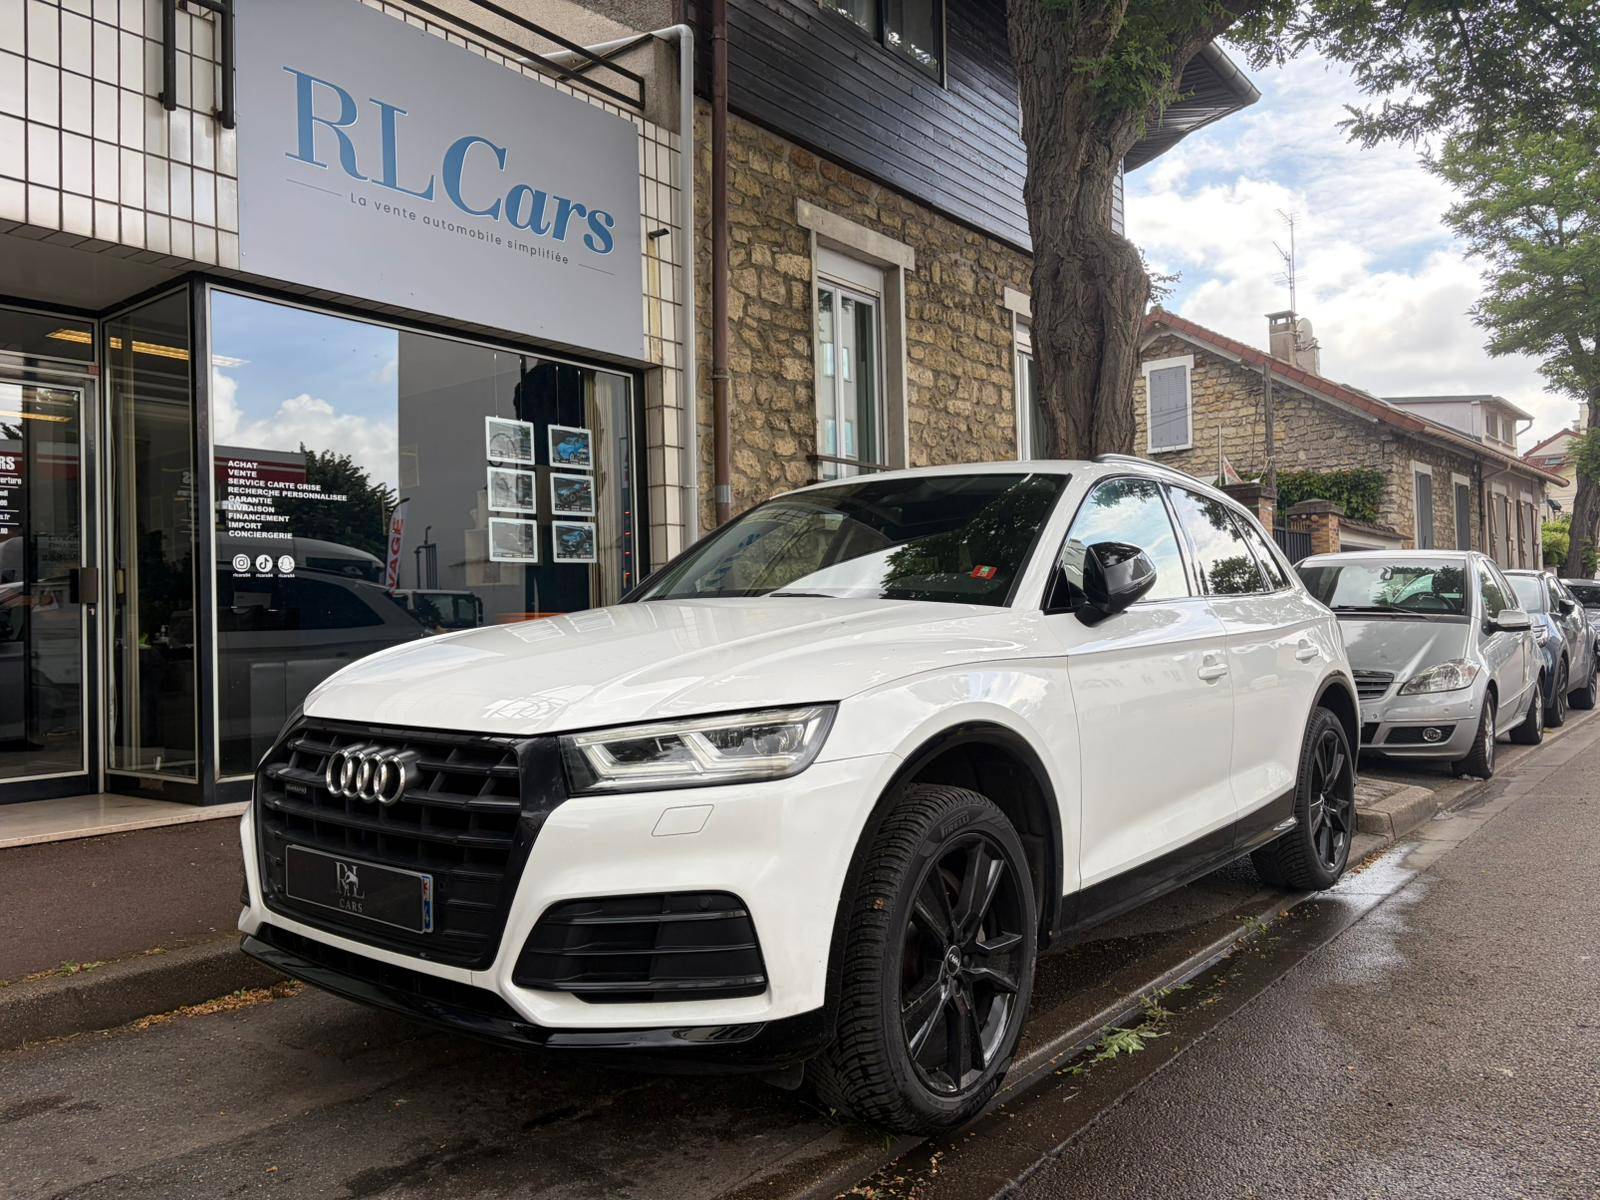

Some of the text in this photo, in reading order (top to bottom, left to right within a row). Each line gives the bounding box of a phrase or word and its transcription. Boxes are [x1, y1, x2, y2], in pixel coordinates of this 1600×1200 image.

[281, 64, 615, 255] RLCars
[350, 192, 569, 264] La vente automobile simplifiée
[228, 460, 258, 469] ACHAT
[228, 469, 257, 478] VENTE
[228, 478, 321, 491] SERVICE CARTE GRISE
[228, 486, 347, 501] RECHERCHE PERSONNALISEE
[228, 495, 273, 504] GARANTIE
[228, 503, 275, 513] LIVRAISON
[228, 512, 290, 522] FINANCEMENT
[228, 521, 262, 529] IMPORT
[229, 530, 293, 539] CONCIERGERIE
[340, 898, 363, 912] CARS
